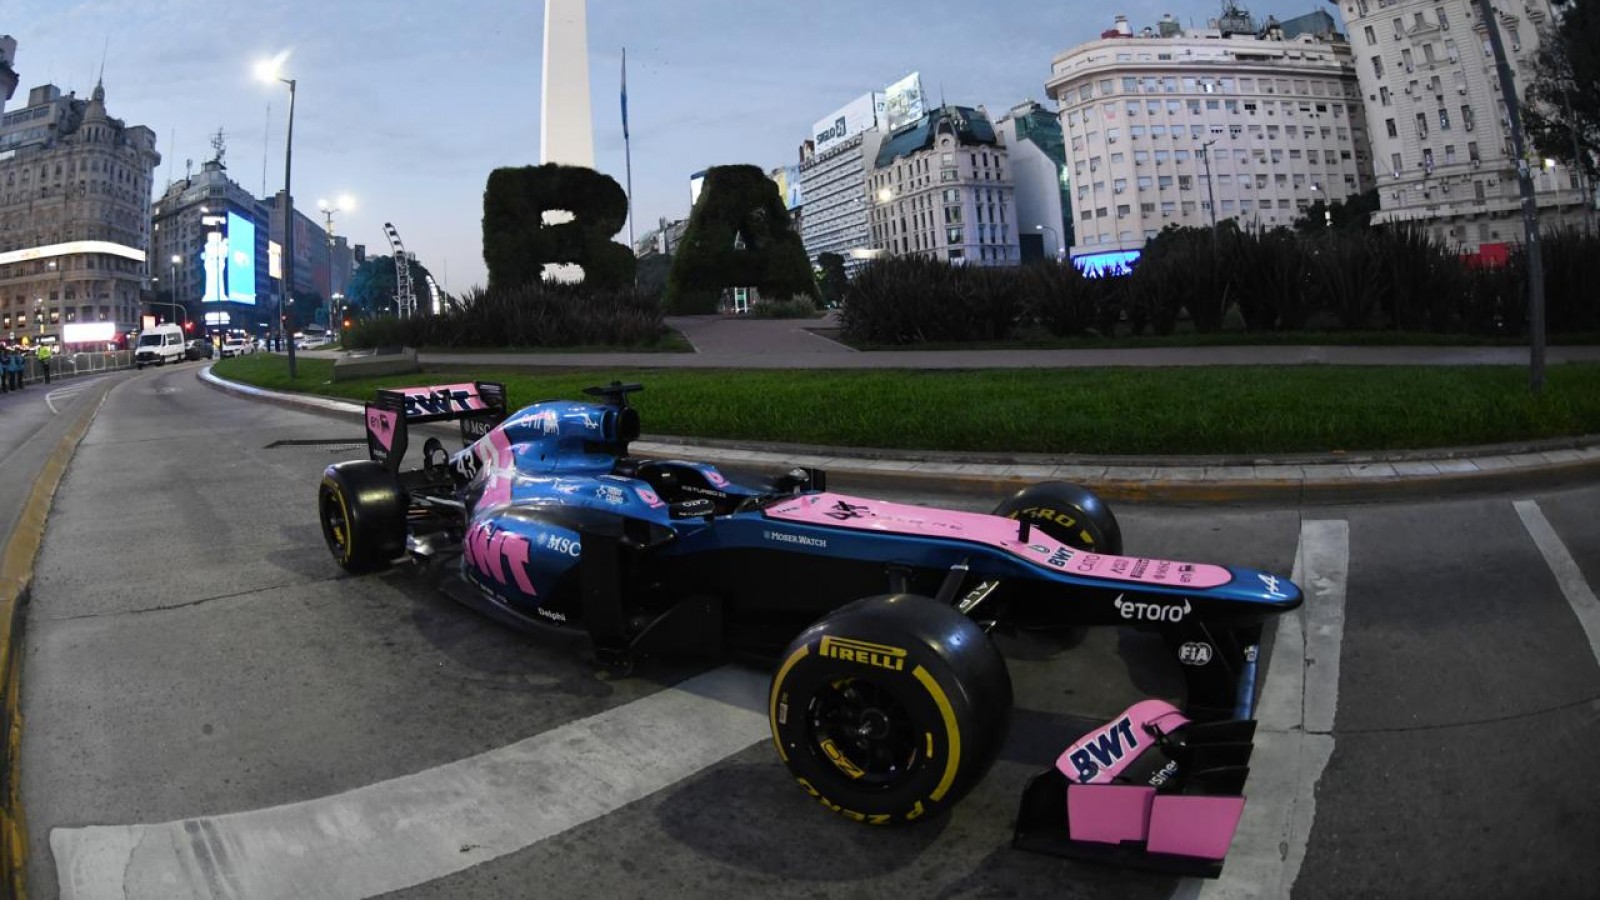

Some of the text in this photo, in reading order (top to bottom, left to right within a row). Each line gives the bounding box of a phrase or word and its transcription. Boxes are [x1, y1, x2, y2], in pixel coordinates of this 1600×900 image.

[547, 534, 582, 558] MSC
[1048, 546, 1075, 568] BWT
[819, 635, 907, 671] PIRELLI
[1180, 644, 1209, 662] FIA
[1069, 716, 1139, 784] BWT
